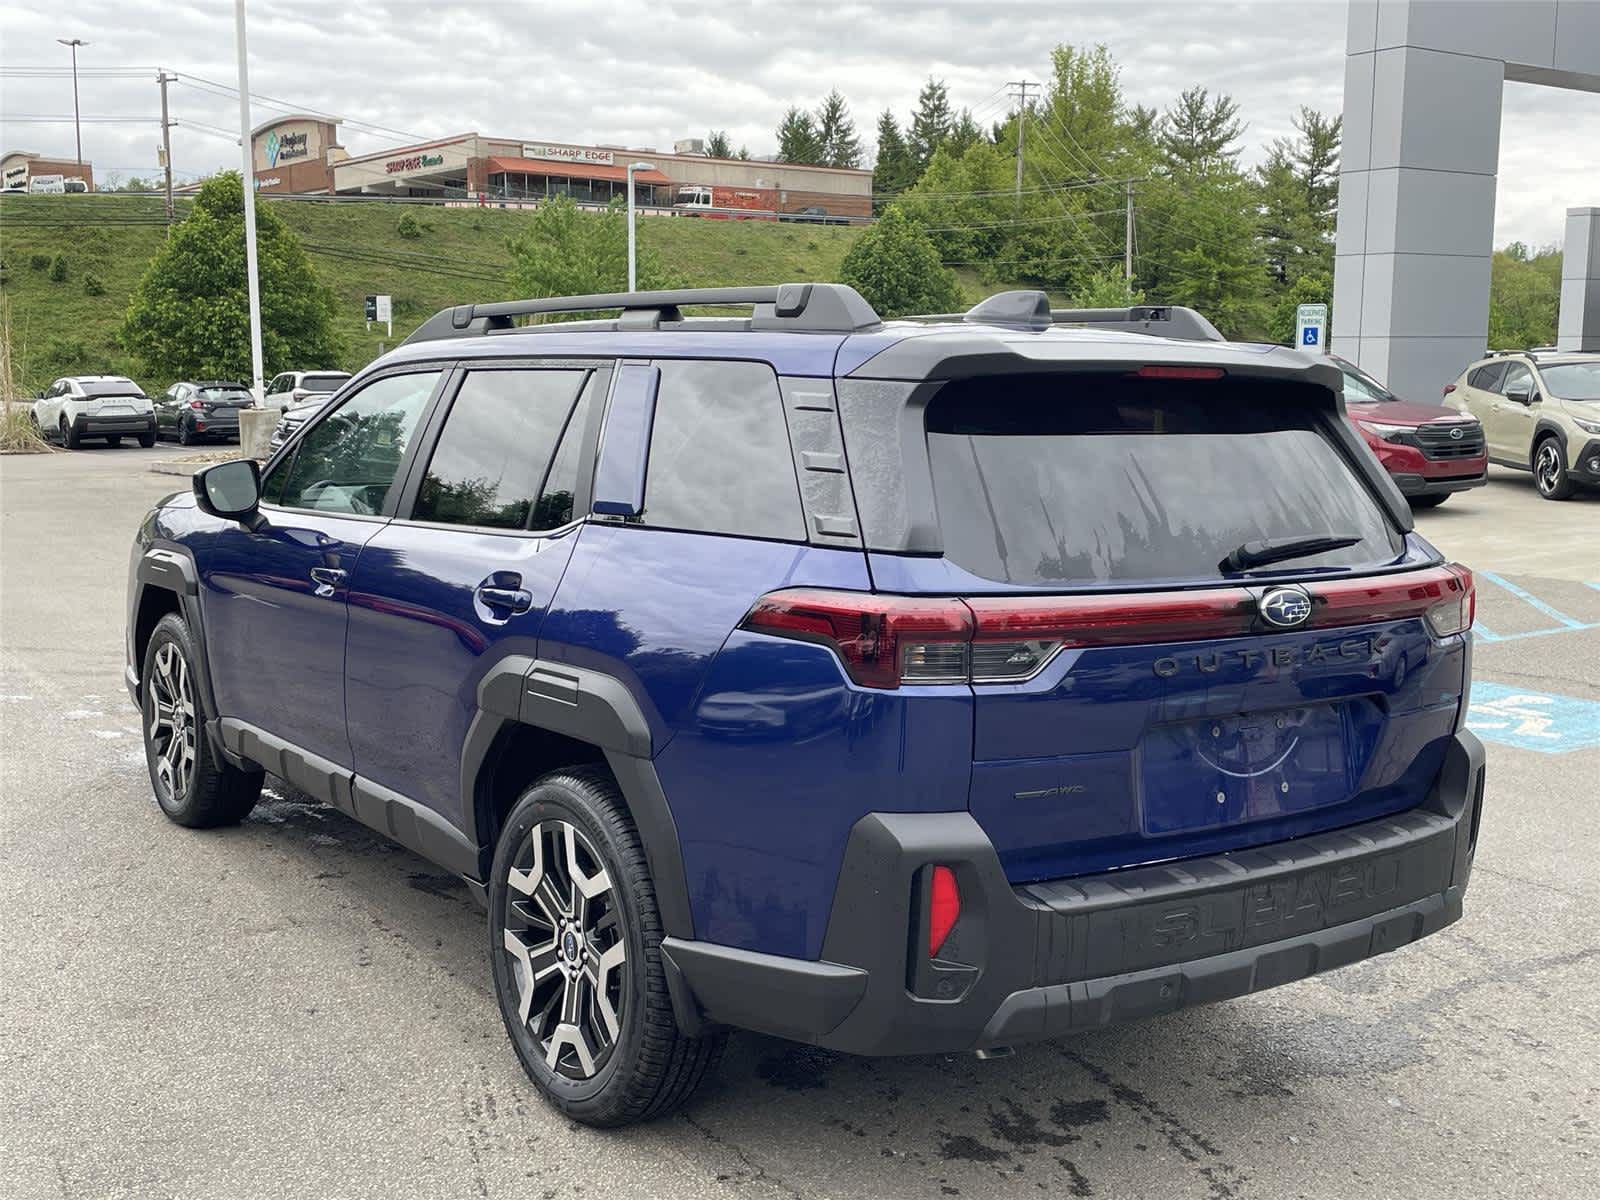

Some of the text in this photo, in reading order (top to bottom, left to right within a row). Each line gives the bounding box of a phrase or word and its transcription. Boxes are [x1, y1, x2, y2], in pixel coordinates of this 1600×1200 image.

[548, 146, 582, 159] SHARP
[585, 150, 612, 161] EDGE
[1152, 636, 1387, 678] OUTBACK
